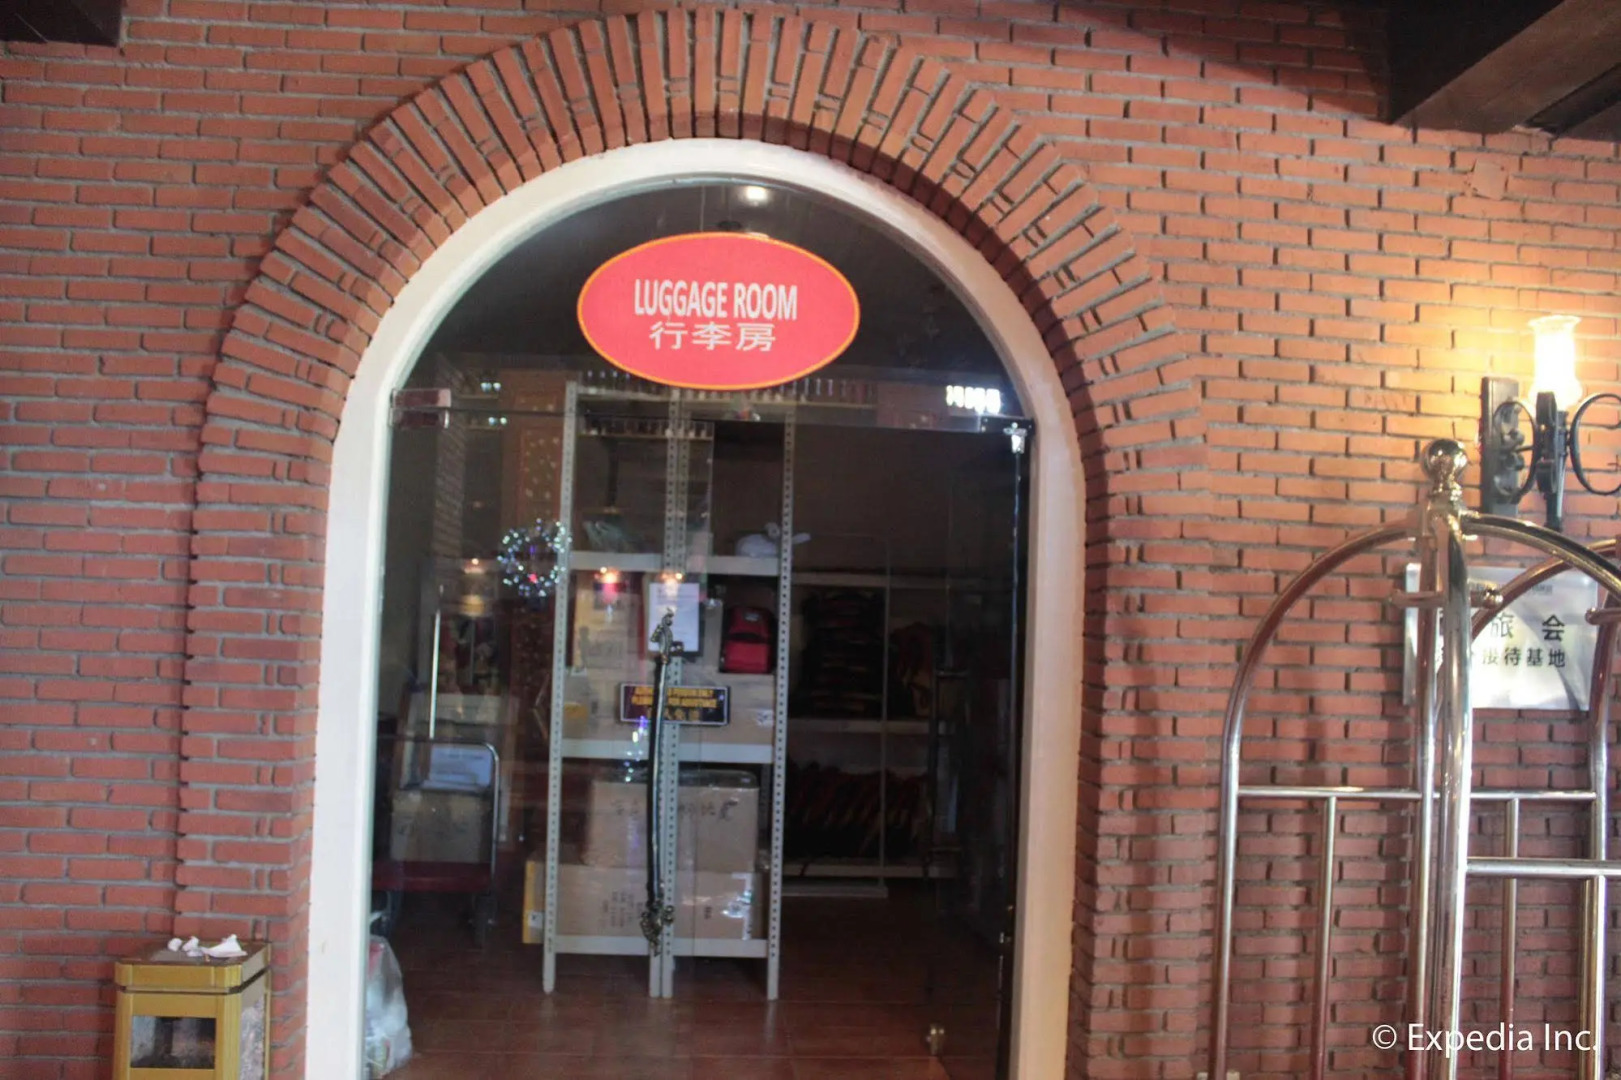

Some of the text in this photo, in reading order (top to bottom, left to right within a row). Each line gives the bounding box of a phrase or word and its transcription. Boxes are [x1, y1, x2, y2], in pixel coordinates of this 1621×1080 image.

[633, 279, 798, 320] LUGGAGE ROOM
[649, 320, 776, 352] 行李房
